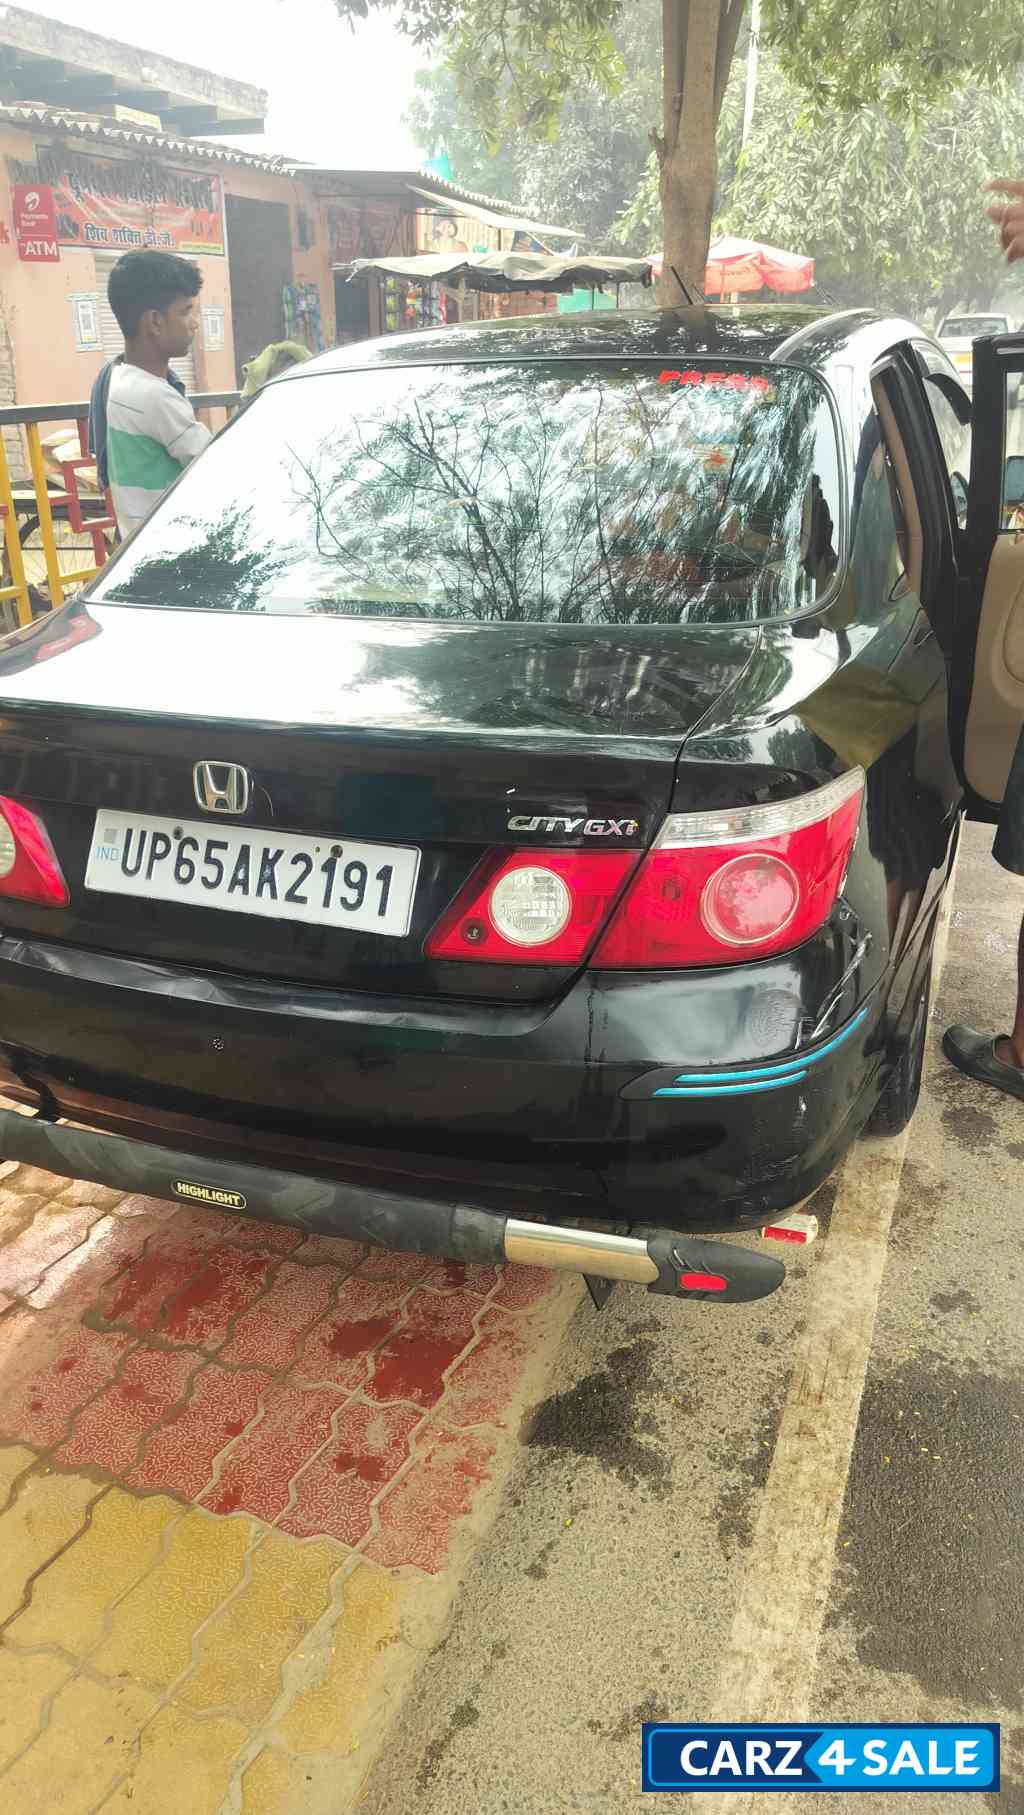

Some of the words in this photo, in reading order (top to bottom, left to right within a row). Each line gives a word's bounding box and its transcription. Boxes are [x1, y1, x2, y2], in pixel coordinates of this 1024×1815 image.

[25, 241, 57, 257] ATM
[507, 815, 585, 833] CITY
[96, 846, 119, 861] IND
[120, 827, 394, 917] UP65AK2191
[177, 1182, 241, 1206] HIGHLIGHT
